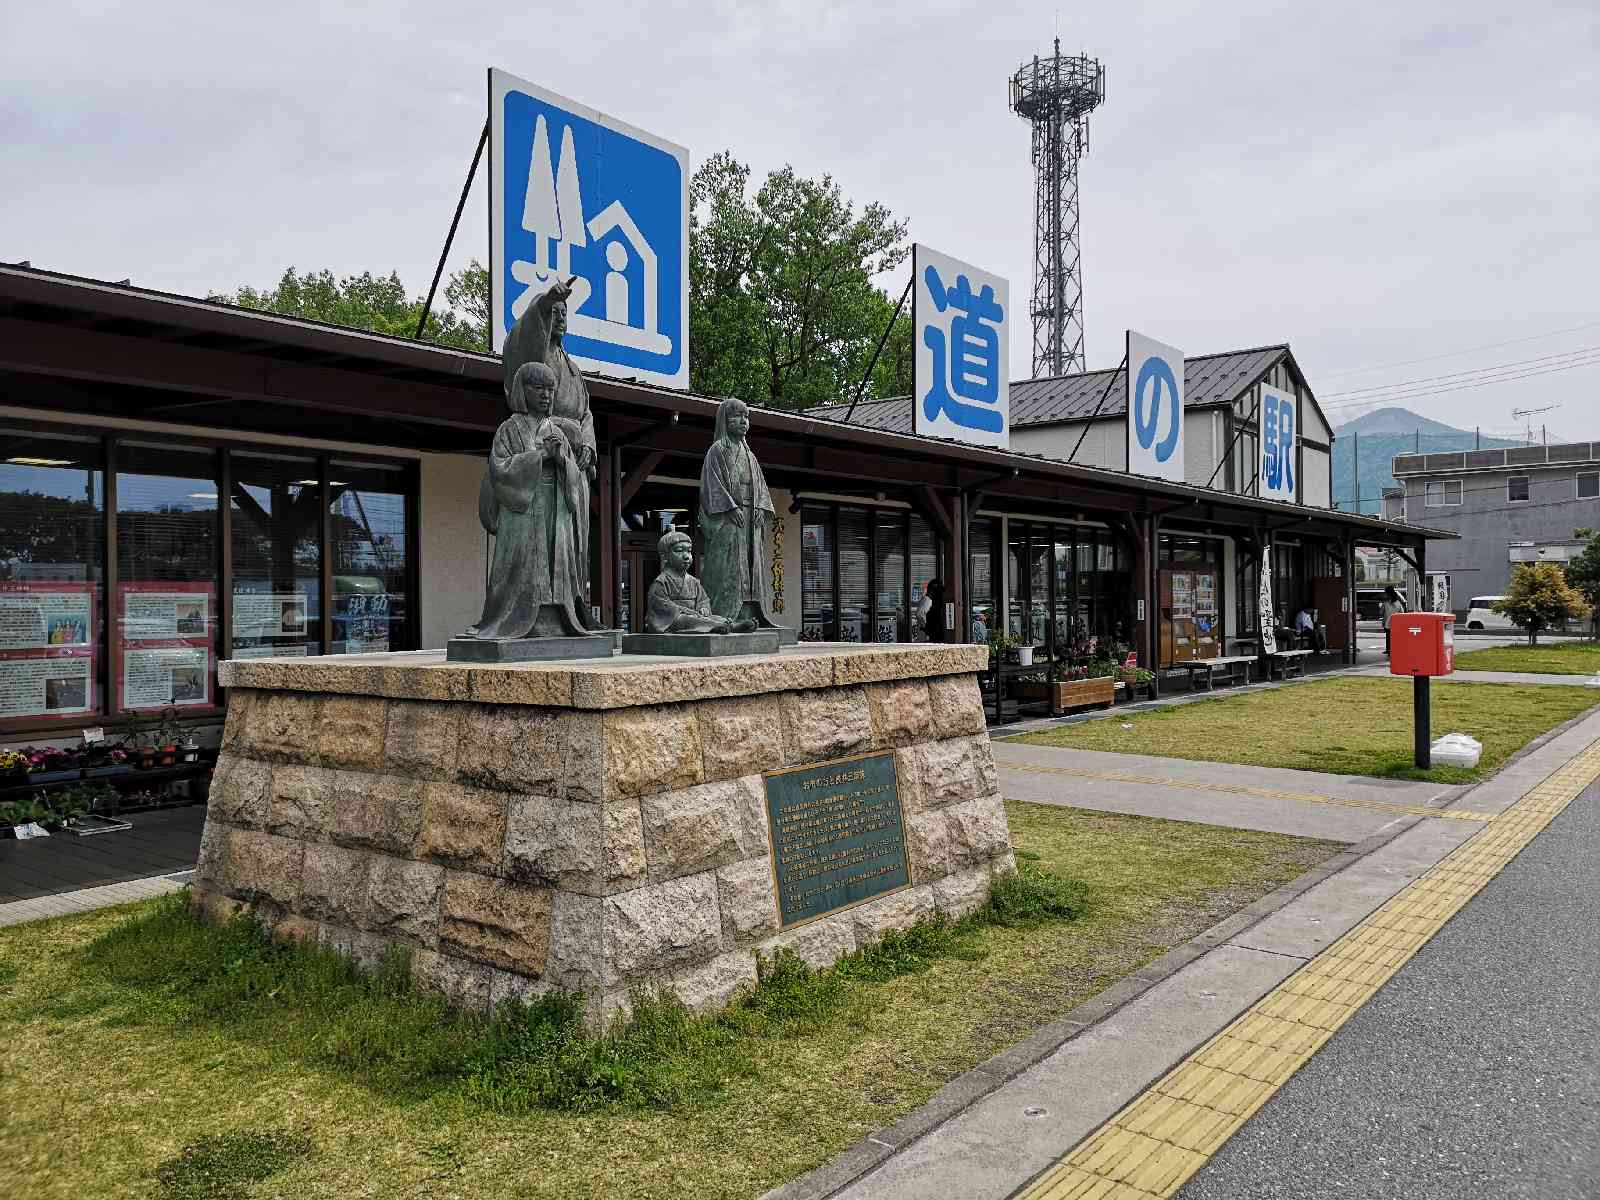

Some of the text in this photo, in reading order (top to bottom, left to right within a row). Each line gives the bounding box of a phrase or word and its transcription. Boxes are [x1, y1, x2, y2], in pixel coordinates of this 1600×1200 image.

[923, 264, 1295, 493] 道 の 駅
